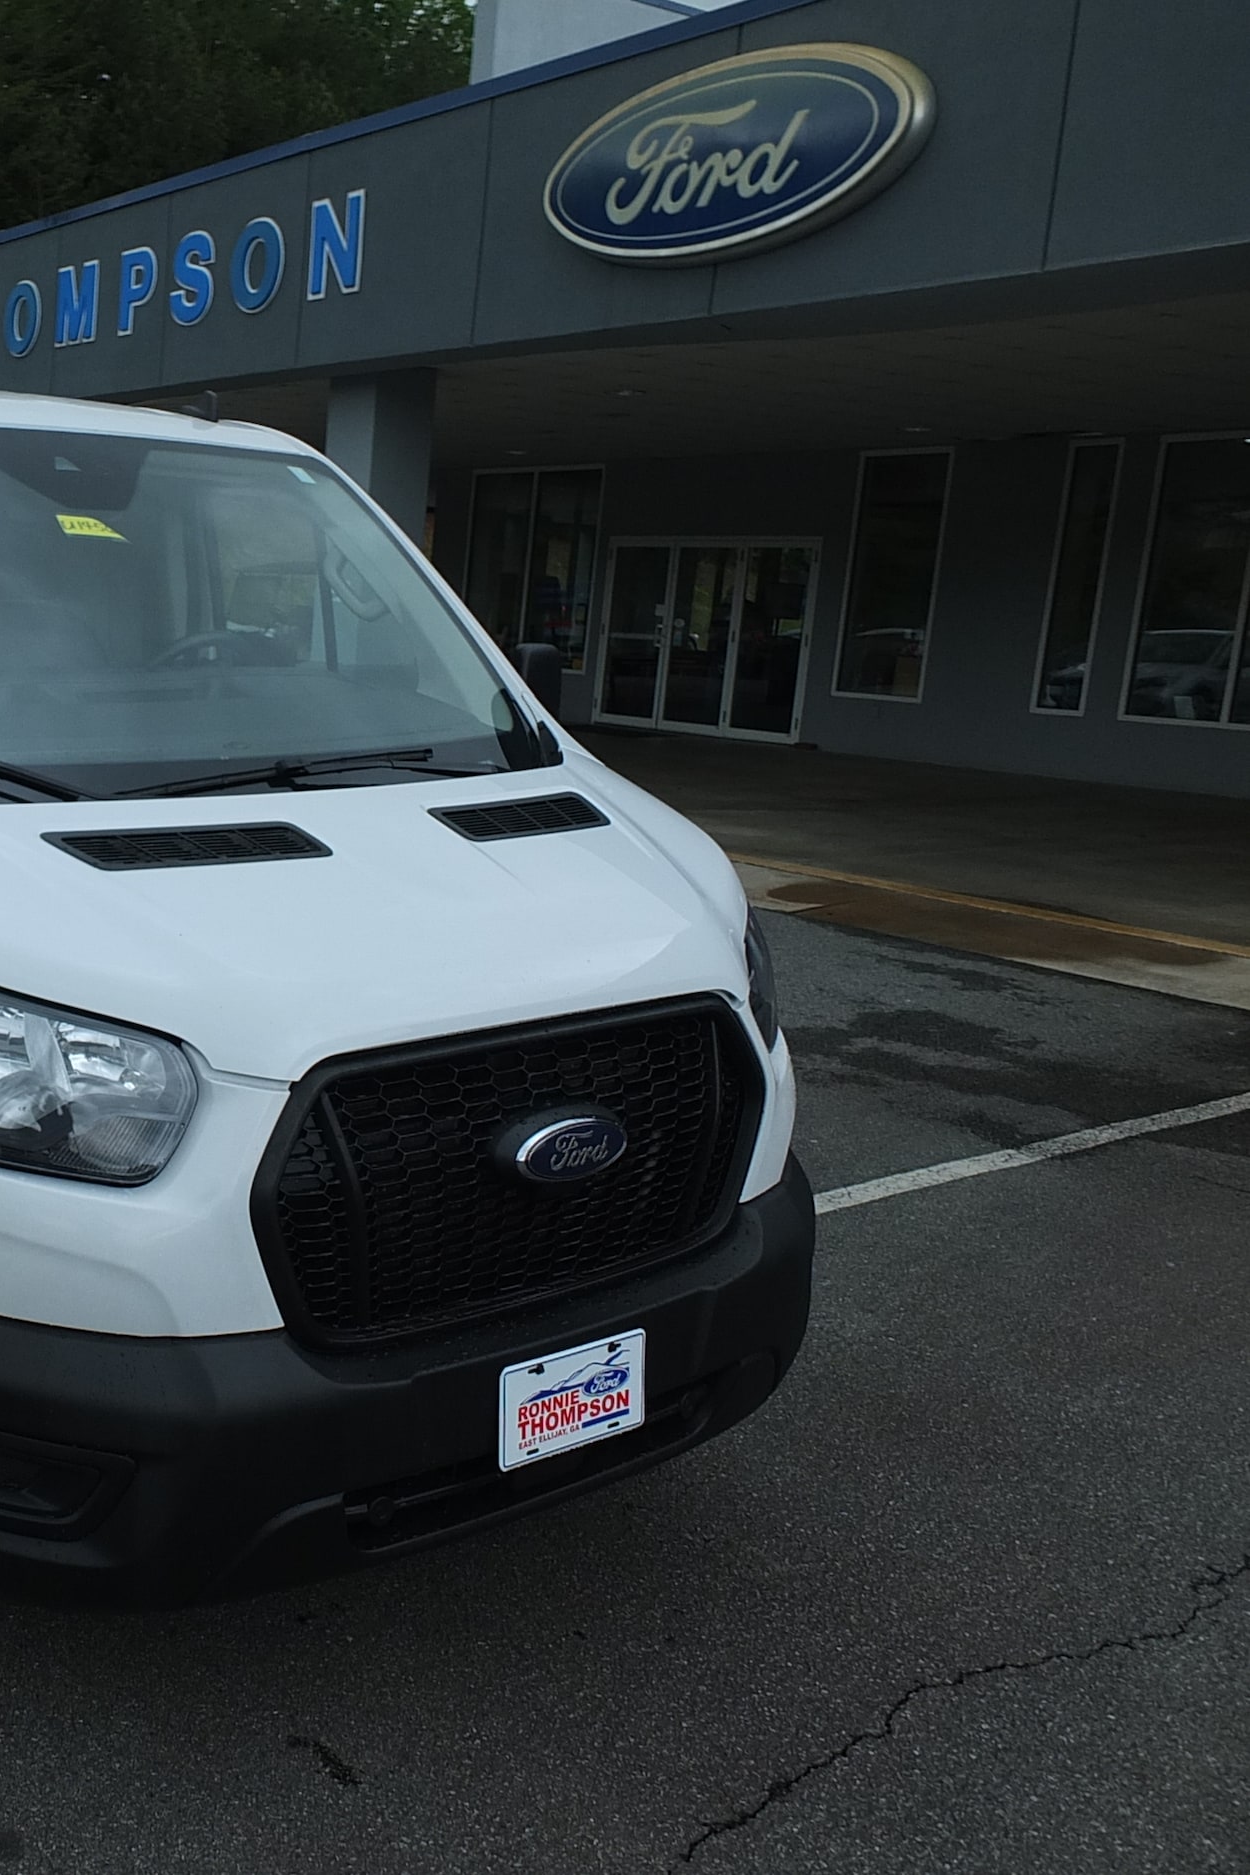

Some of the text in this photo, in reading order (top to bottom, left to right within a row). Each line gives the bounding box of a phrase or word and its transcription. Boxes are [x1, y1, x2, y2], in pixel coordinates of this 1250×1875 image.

[605, 99, 810, 226] Ford
[550, 1129, 609, 1171] Ford
[590, 1371, 622, 1393] Ford
[517, 1389, 630, 1441] THOMPSON
[518, 1389, 580, 1422] RONNIE
[518, 1437, 537, 1450] EAST
[569, 1424, 580, 1434] GA
